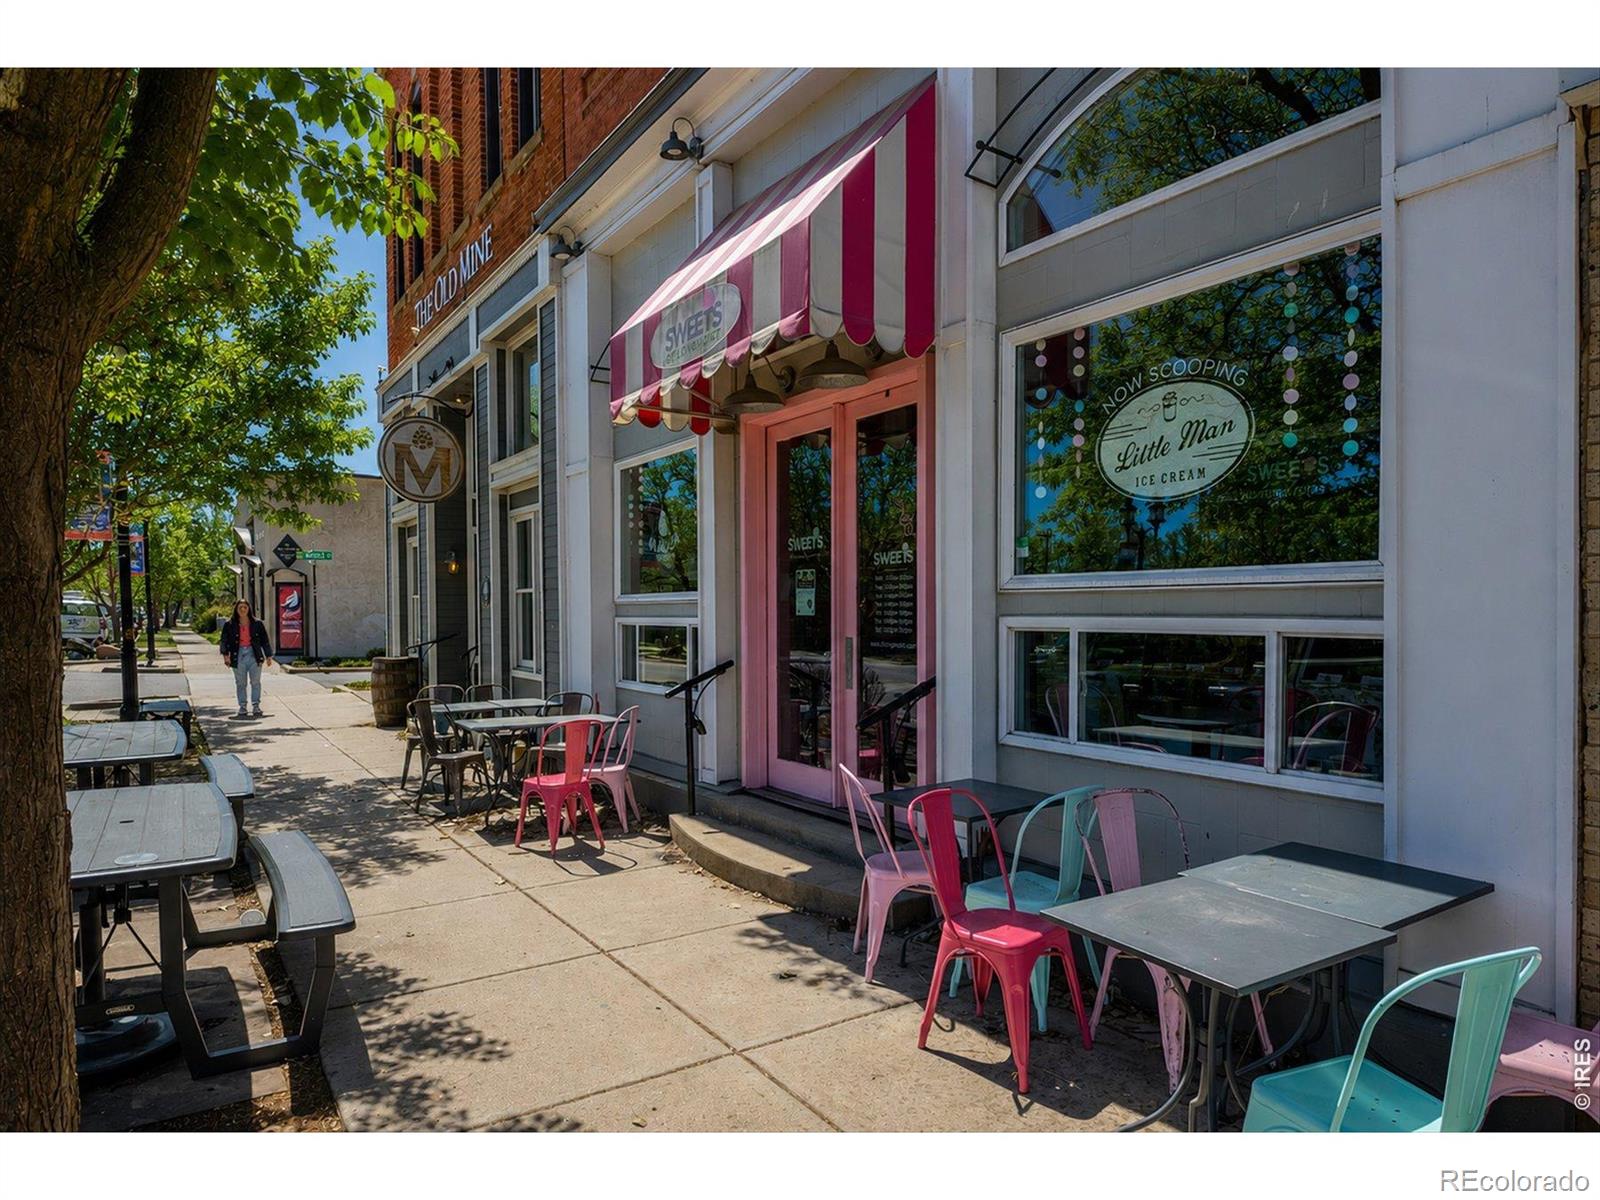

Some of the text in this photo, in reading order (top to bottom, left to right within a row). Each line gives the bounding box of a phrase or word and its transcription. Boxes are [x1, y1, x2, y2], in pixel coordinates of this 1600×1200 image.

[415, 224, 494, 329] THE OLD MINE
[665, 300, 723, 352] SWEETS
[1102, 358, 1249, 415] NOW SCOOPING
[392, 441, 451, 494] M
[1114, 418, 1237, 473] Little Man
[1247, 456, 1330, 481] SWEES
[1135, 467, 1207, 487] ICE CREAM
[787, 531, 824, 552] SWEETS
[873, 545, 915, 566] SWEETS
